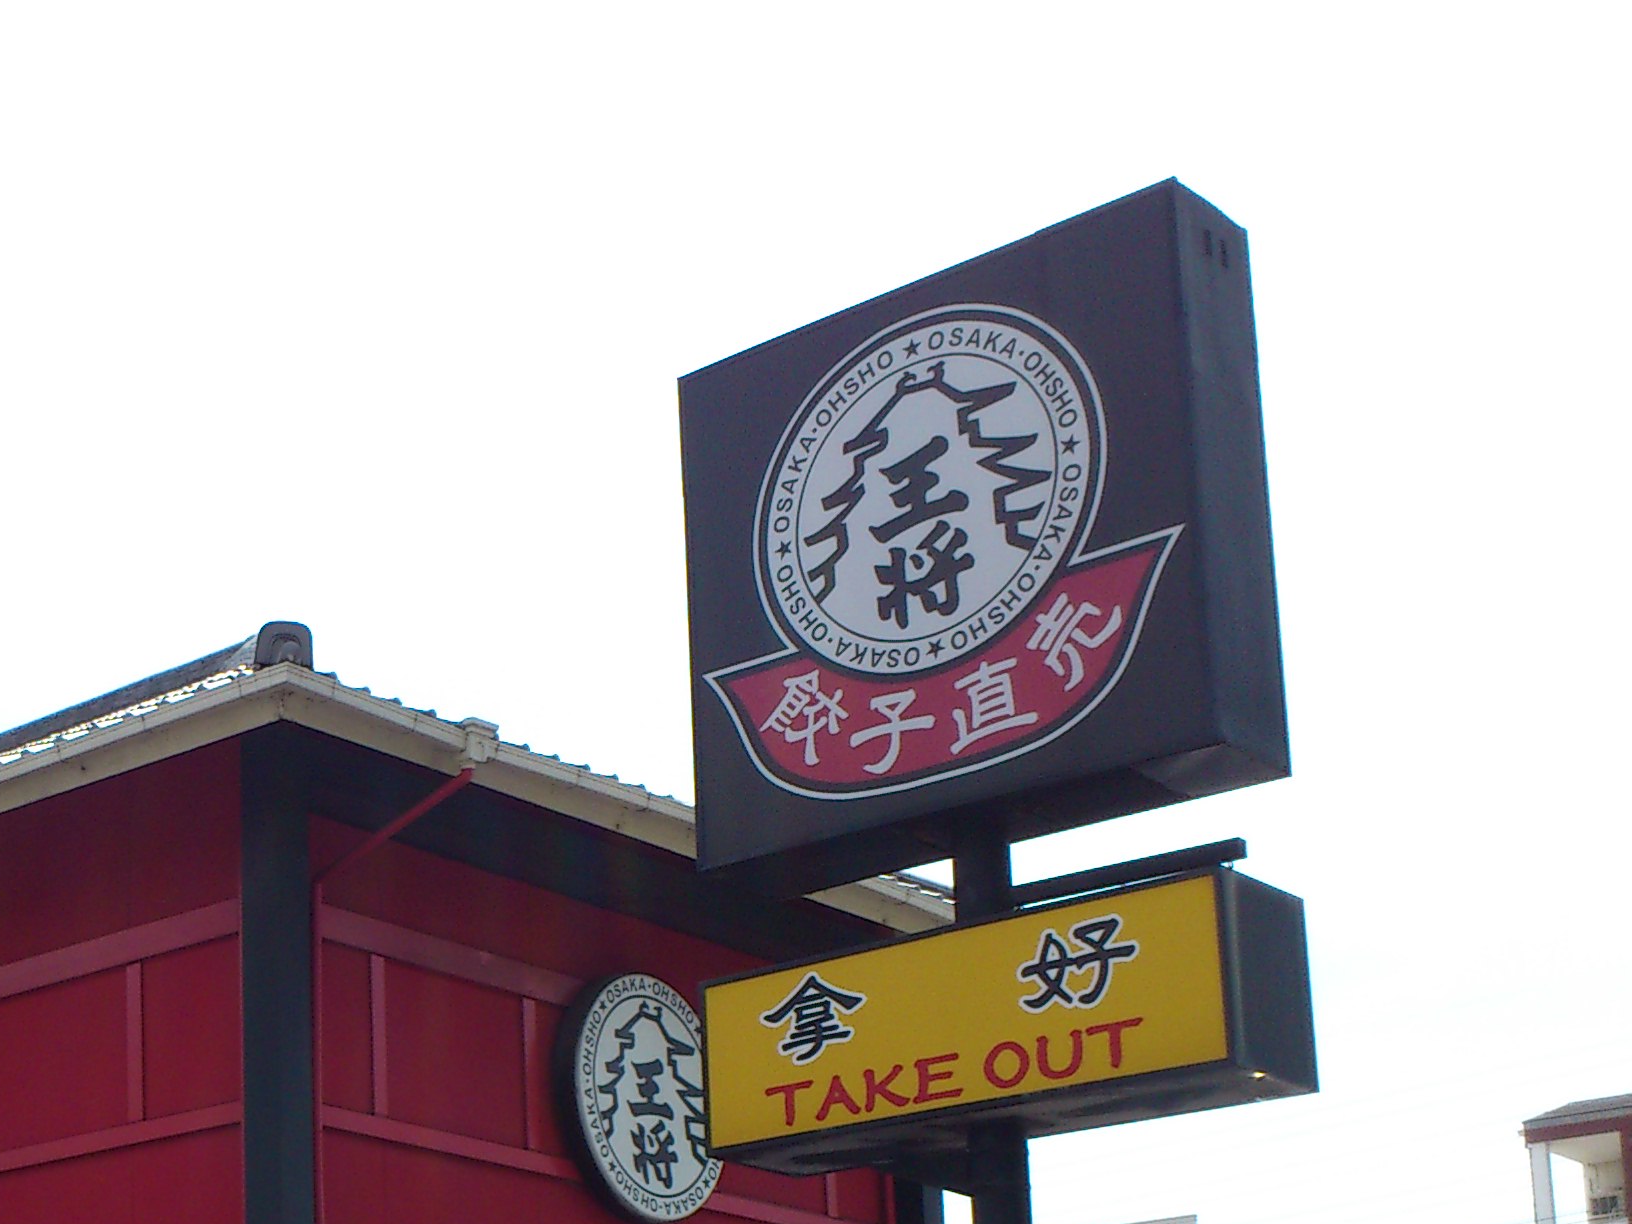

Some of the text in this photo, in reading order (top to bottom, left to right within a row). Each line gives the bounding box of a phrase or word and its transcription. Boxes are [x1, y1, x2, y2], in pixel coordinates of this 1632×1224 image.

[868, 434, 975, 630] 王将
[759, 592, 1123, 774] 餃子直売
[765, 1016, 1144, 1127] TAKE OUT
